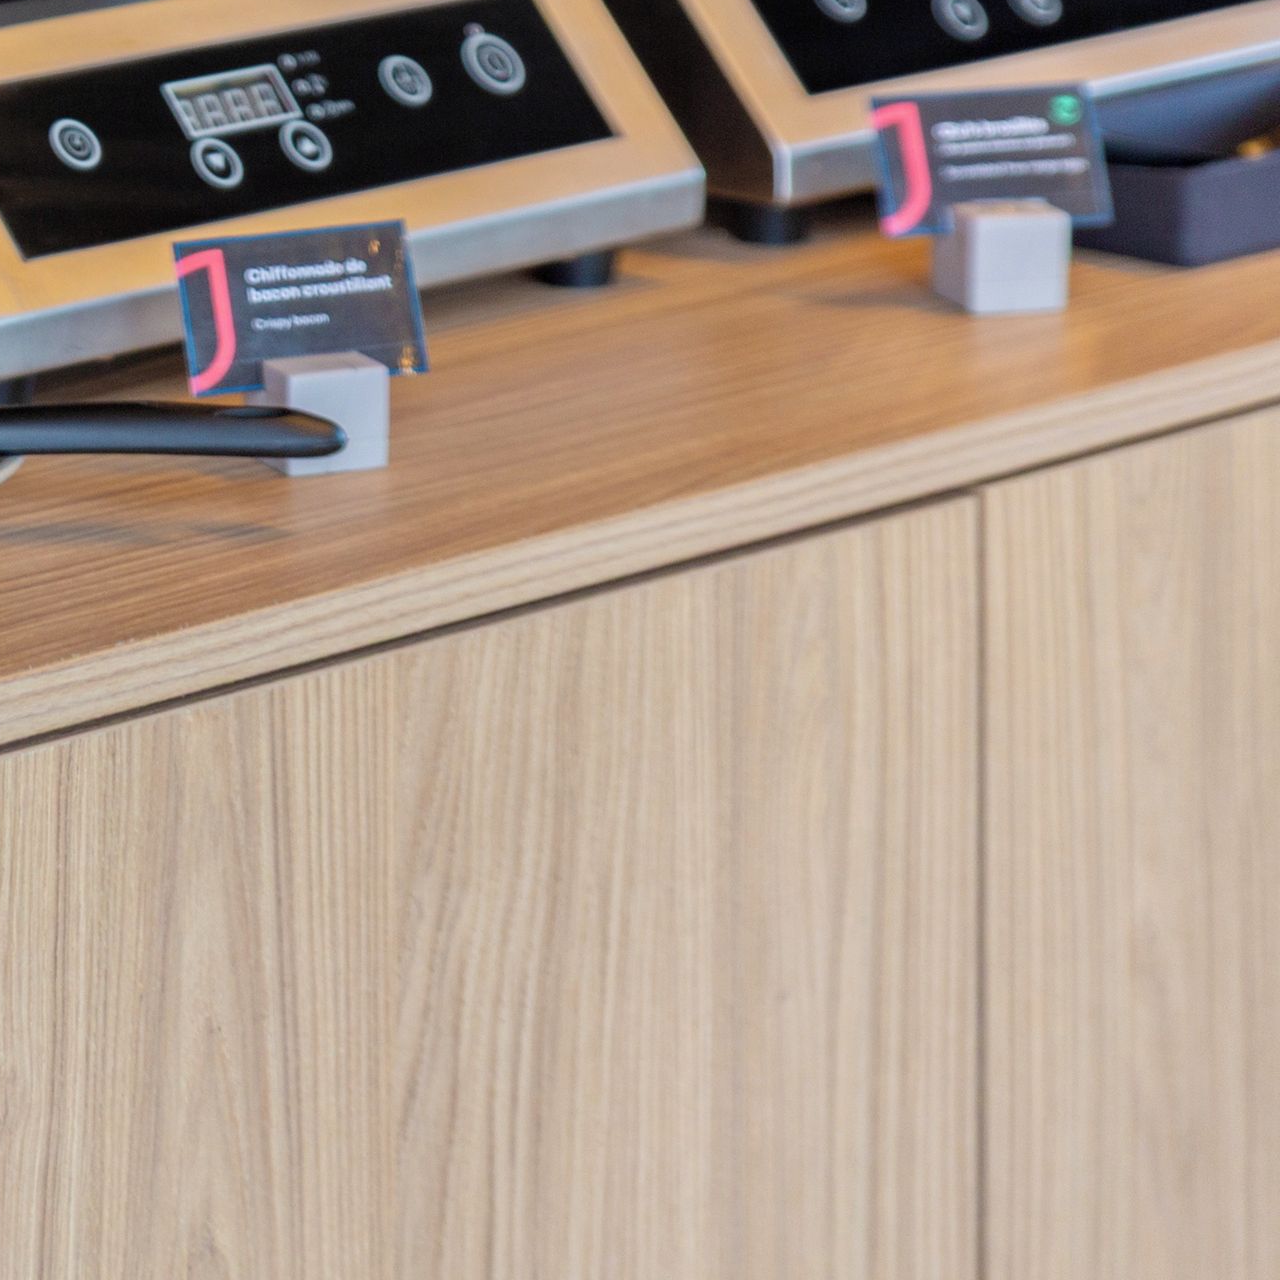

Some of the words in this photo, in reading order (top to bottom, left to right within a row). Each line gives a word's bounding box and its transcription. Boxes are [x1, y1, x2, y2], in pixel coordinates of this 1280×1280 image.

[244, 260, 344, 285] Chiffonnade
[345, 257, 367, 274] de
[247, 285, 301, 304] bacon
[301, 274, 393, 297] croustillant
